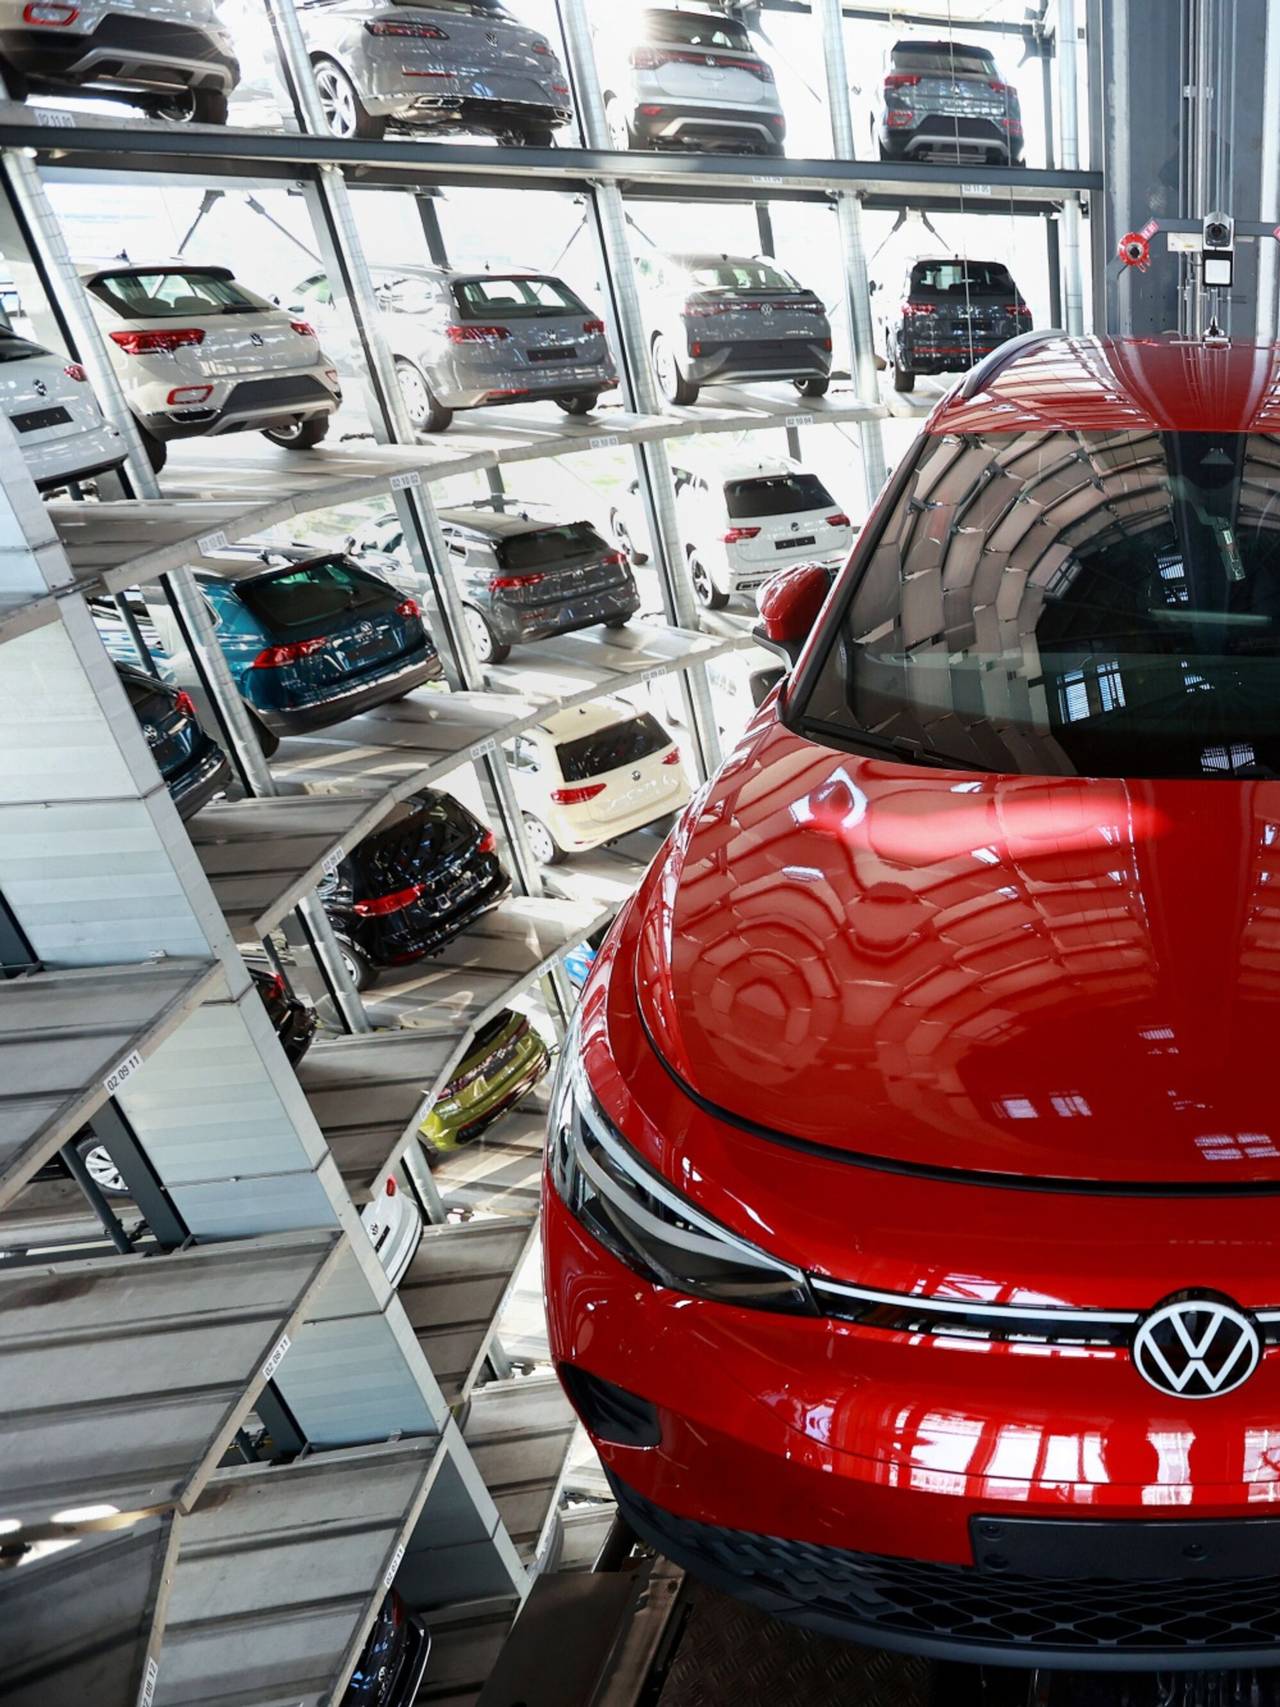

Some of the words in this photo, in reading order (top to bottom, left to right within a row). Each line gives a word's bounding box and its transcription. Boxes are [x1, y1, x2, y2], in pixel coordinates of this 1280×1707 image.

[106, 1077, 118, 1091] 02
[117, 1065, 130, 1080] 09
[128, 1054, 140, 1069] 11
[265, 1362, 273, 1377] 02
[279, 1338, 289, 1352] 11
[147, 1662, 157, 1679] 12
